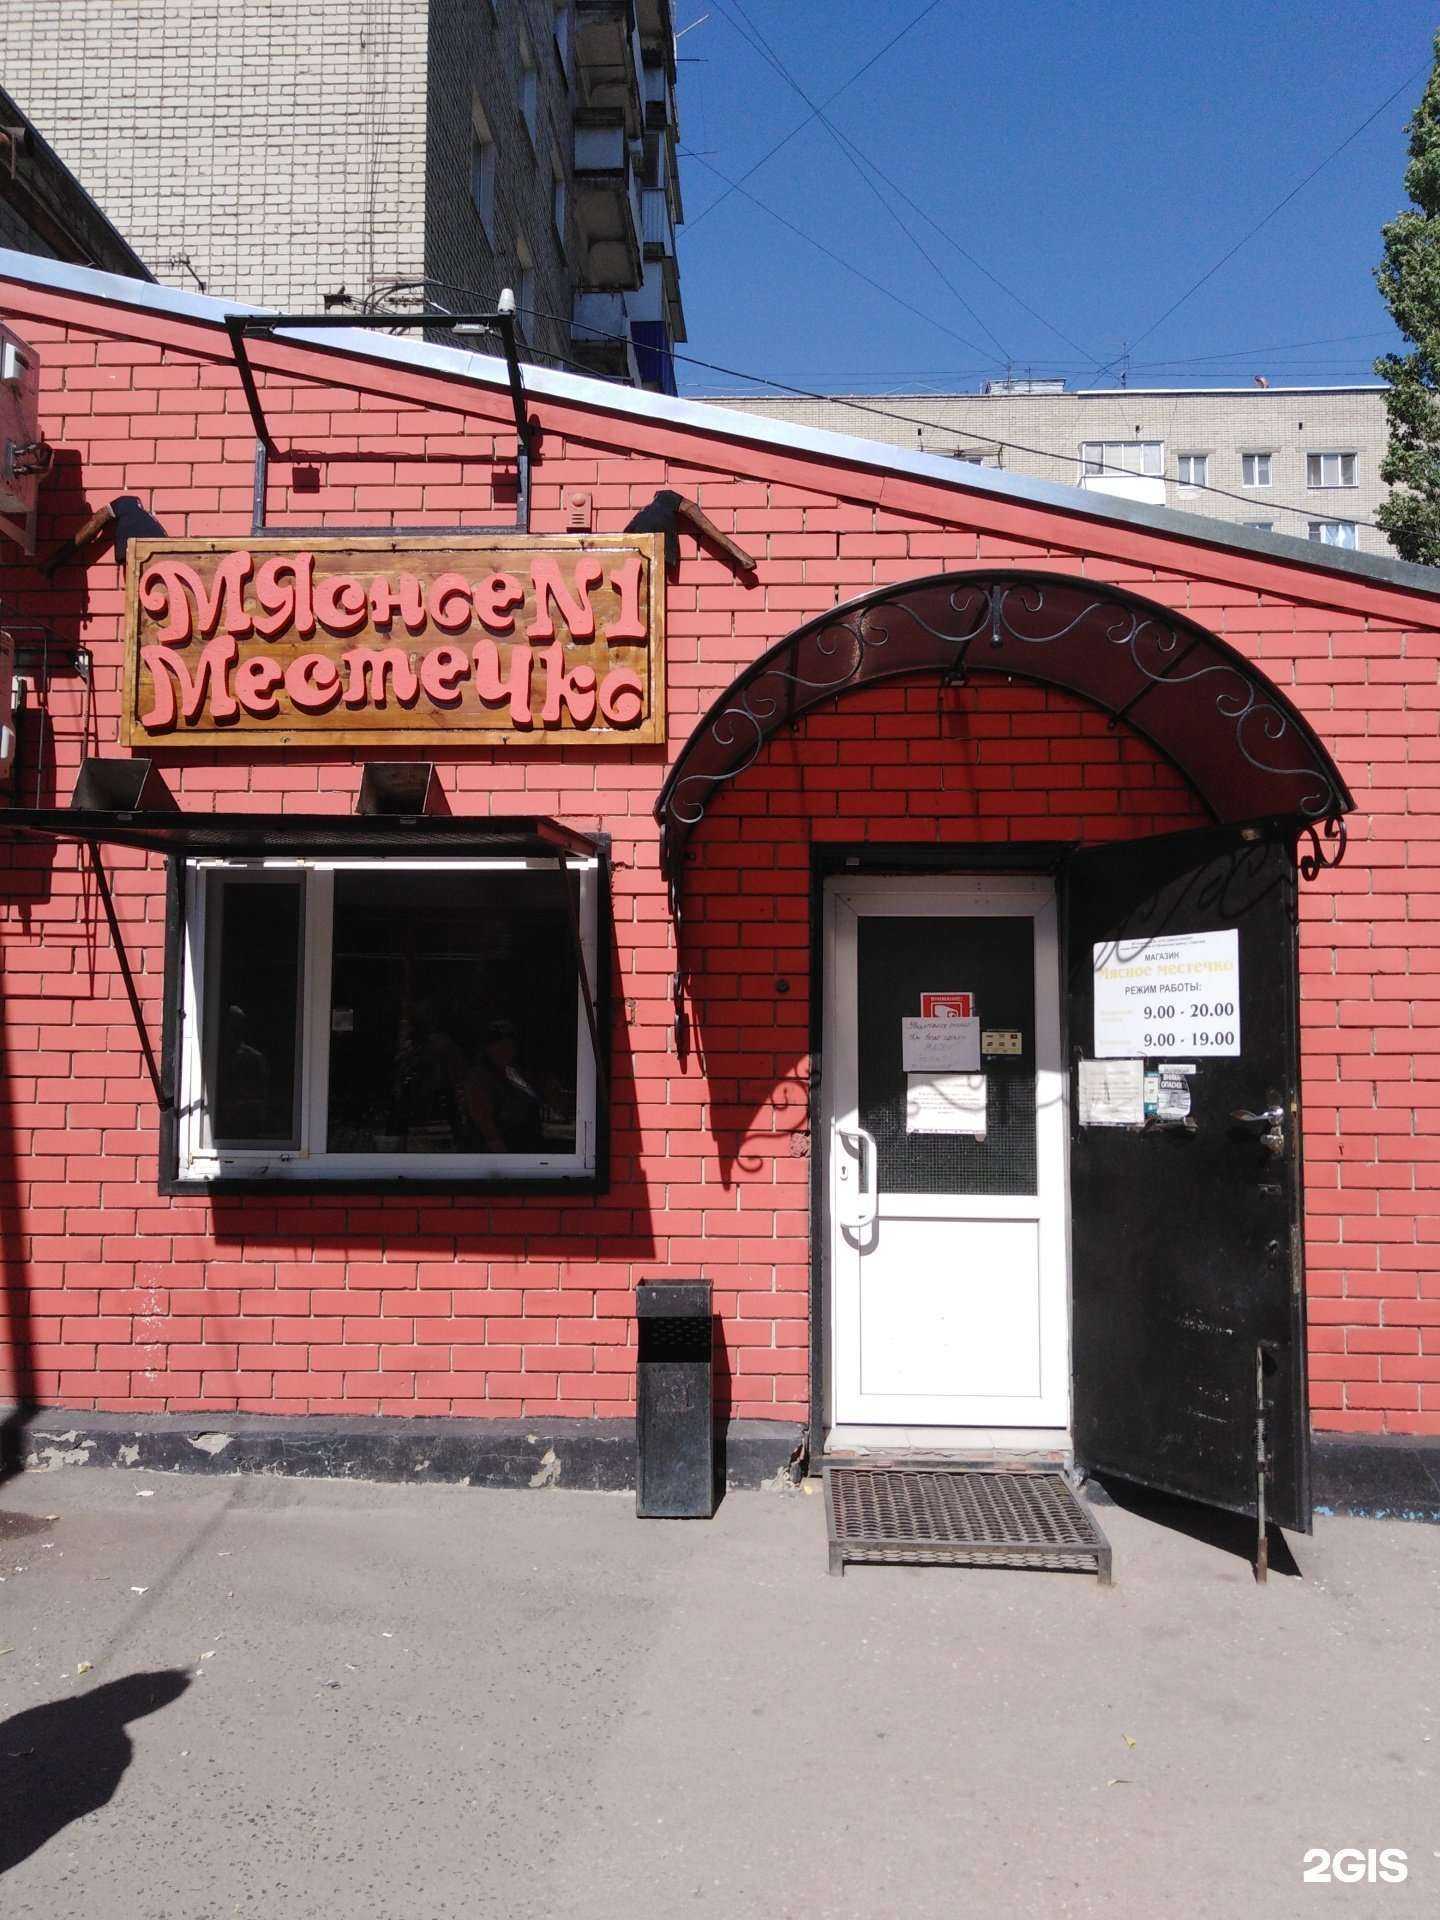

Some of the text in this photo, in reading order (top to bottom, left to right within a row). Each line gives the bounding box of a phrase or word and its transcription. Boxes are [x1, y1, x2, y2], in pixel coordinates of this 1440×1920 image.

[140, 634, 644, 736] Местечко
[1144, 951, 1180, 962] МАГАЗИН
[1124, 982, 1202, 995] РЕЖИМ РАБОТЫ:
[1143, 1005, 1175, 1020] 9.00
[1190, 1002, 1234, 1018] 20.00
[1143, 1033, 1175, 1047] 9.00
[1191, 1031, 1235, 1046] 19.00
